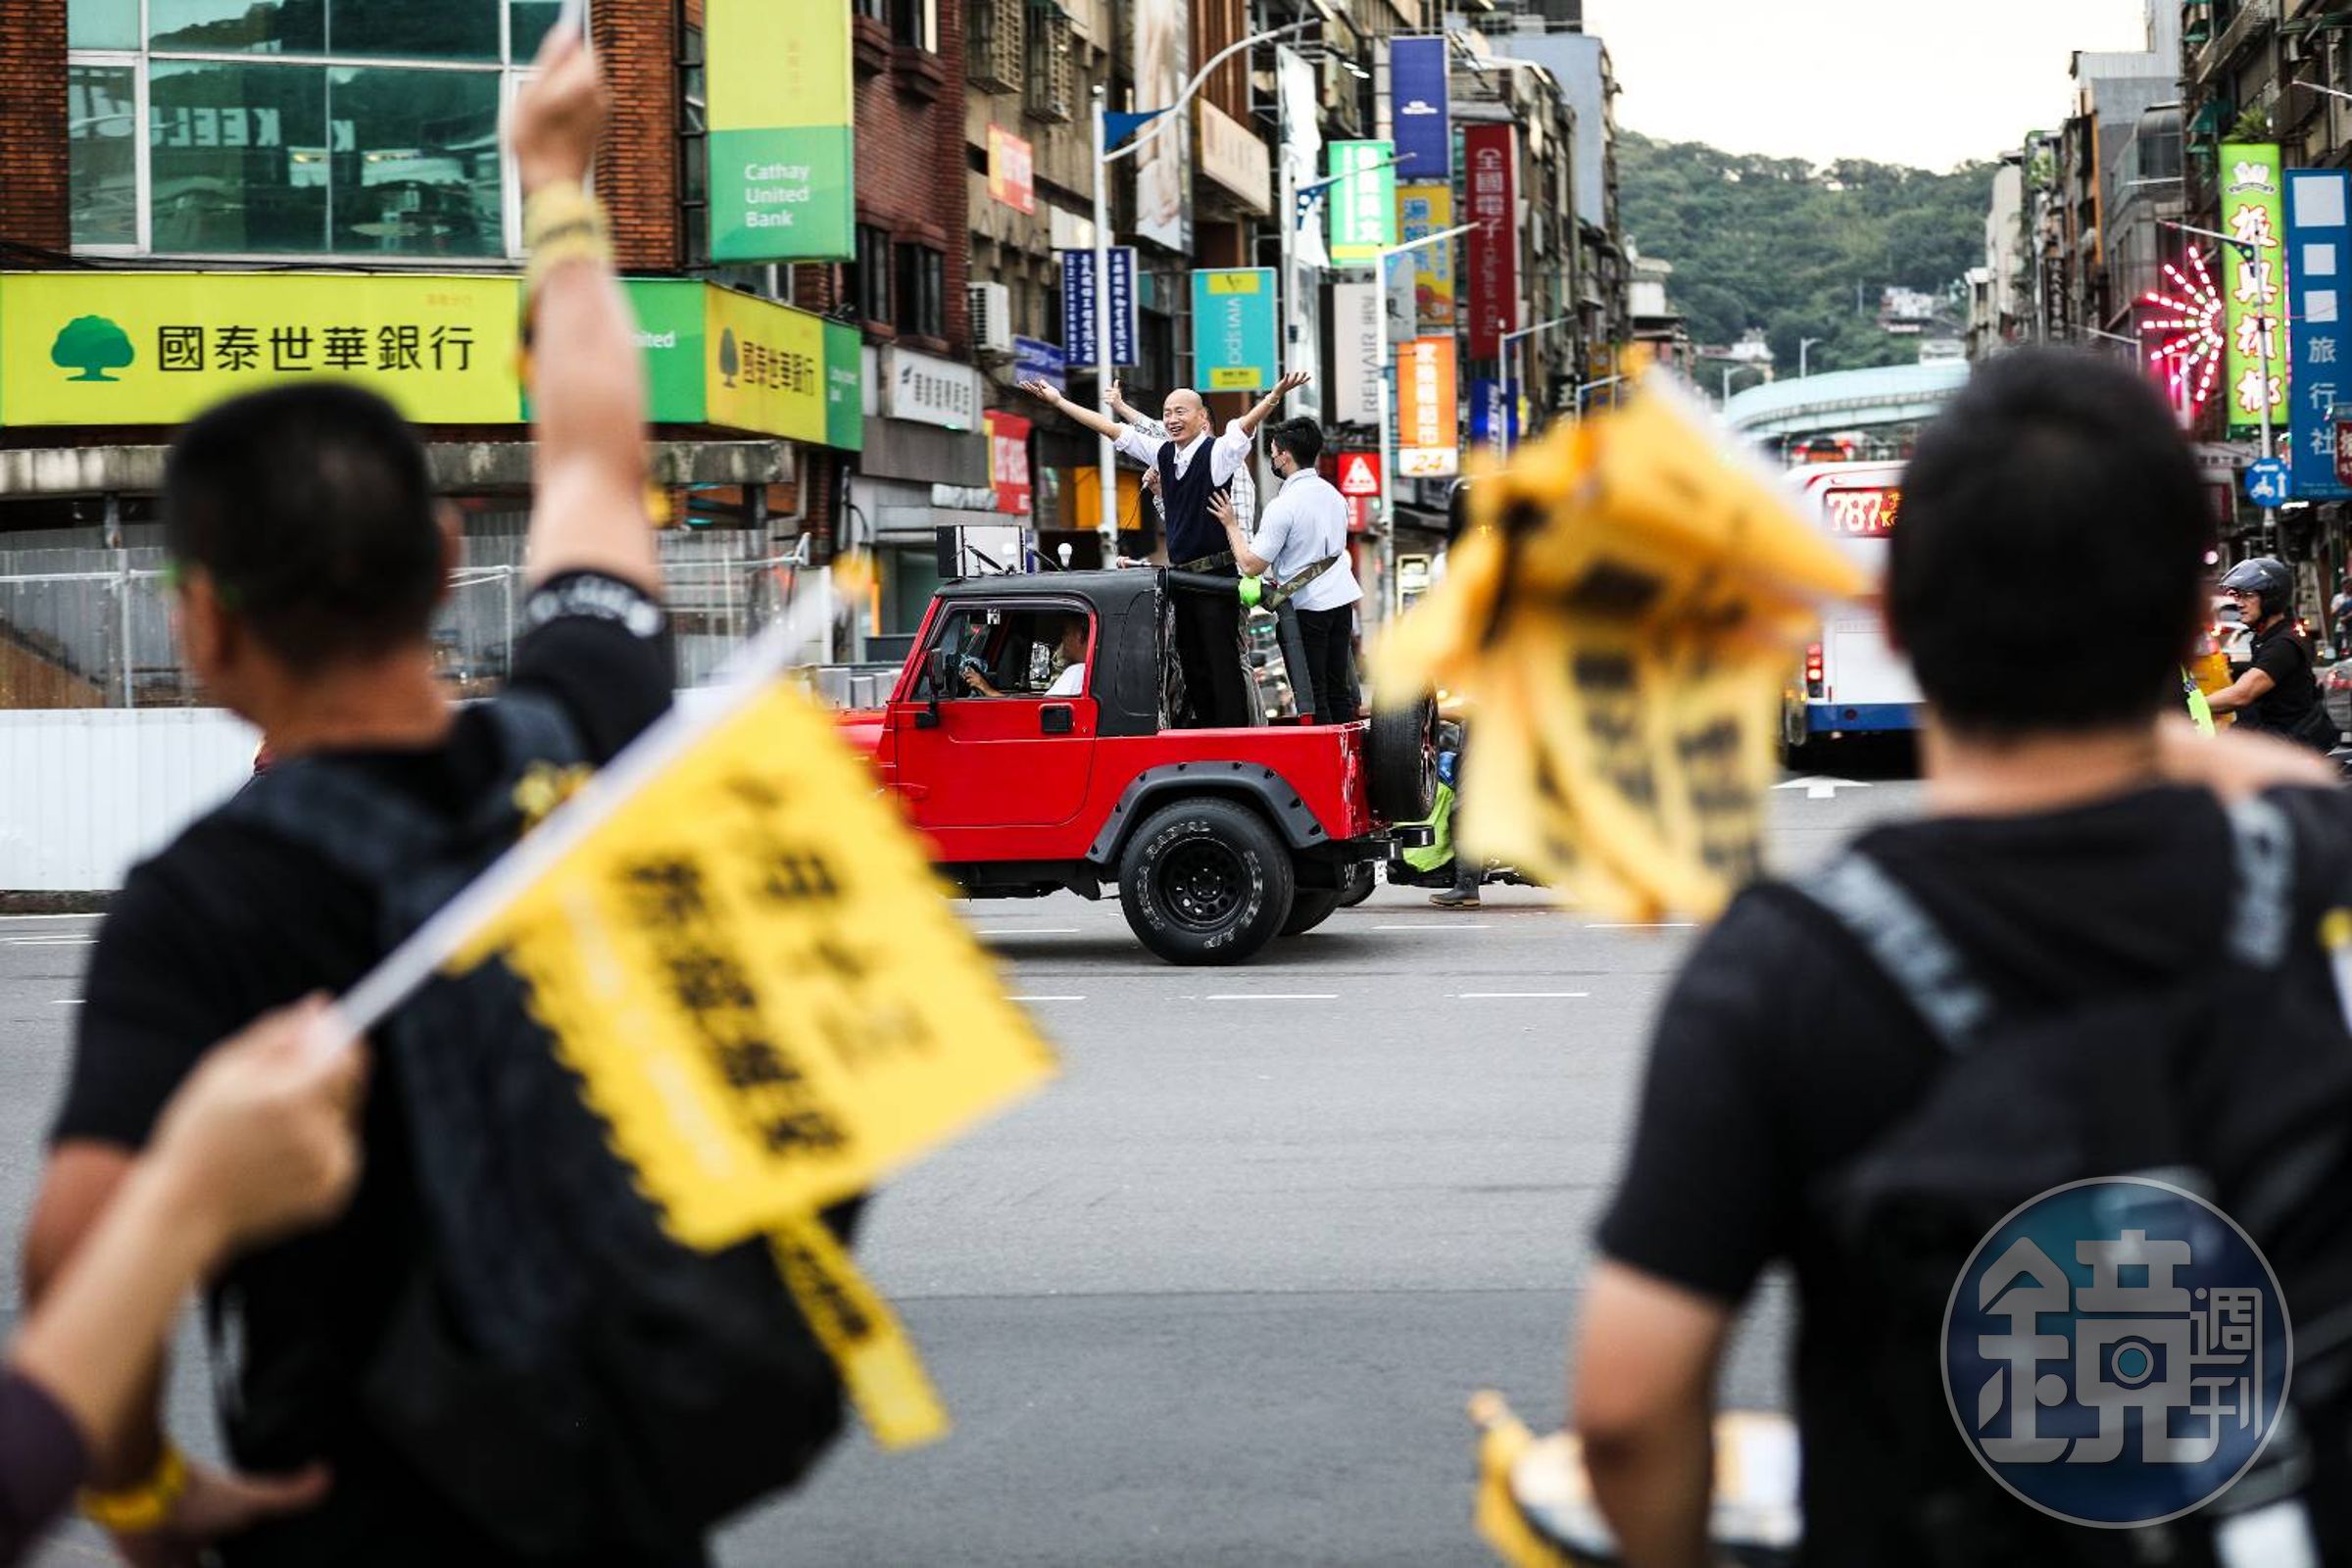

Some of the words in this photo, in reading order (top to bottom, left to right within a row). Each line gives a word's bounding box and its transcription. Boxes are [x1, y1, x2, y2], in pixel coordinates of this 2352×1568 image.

[745, 163, 810, 182] Cathay
[745, 185, 810, 204] United
[1475, 147, 1504, 240] 全國電子
[745, 209, 795, 227] Bank
[158, 324, 475, 372] 國泰世華銀行
[633, 330, 676, 349] nited
[2308, 336, 2338, 456] 旅行社
[1411, 453, 1443, 472] 24
[1826, 492, 1884, 532] 787
